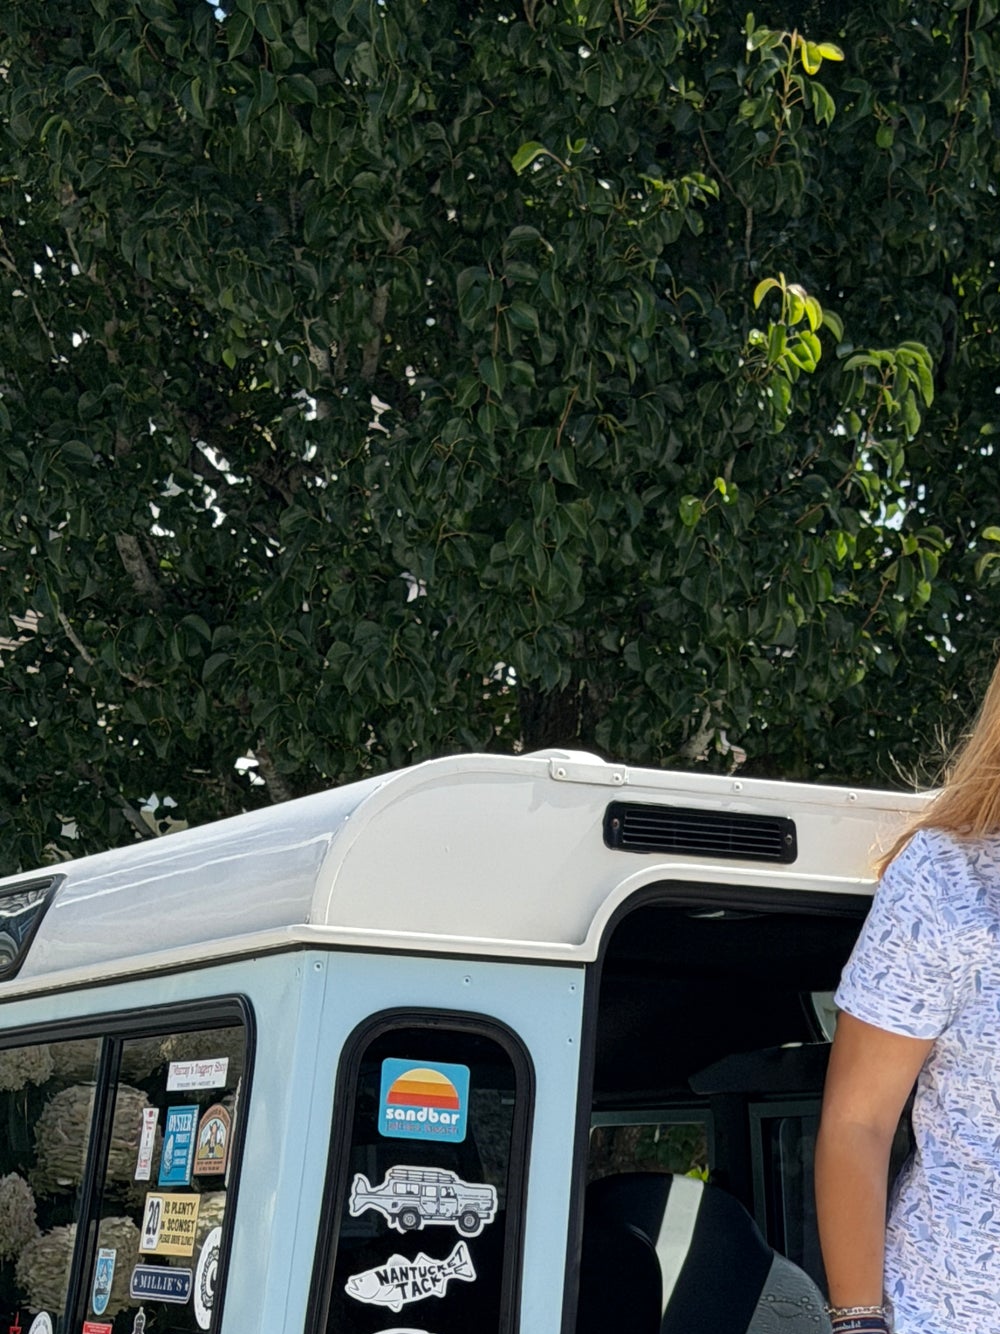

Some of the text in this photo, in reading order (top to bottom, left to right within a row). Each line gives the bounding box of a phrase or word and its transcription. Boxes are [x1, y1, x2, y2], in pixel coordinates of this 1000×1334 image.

[168, 1113, 192, 1131] OYSTER
[386, 1107, 460, 1125] sandbar
[164, 1201, 196, 1216] IS PLENTY
[145, 1200, 160, 1236] 20
[374, 1249, 464, 1286] NANTUCKET
[139, 1274, 182, 1291] MILLIE'S
[395, 1261, 468, 1300] TACKLE
